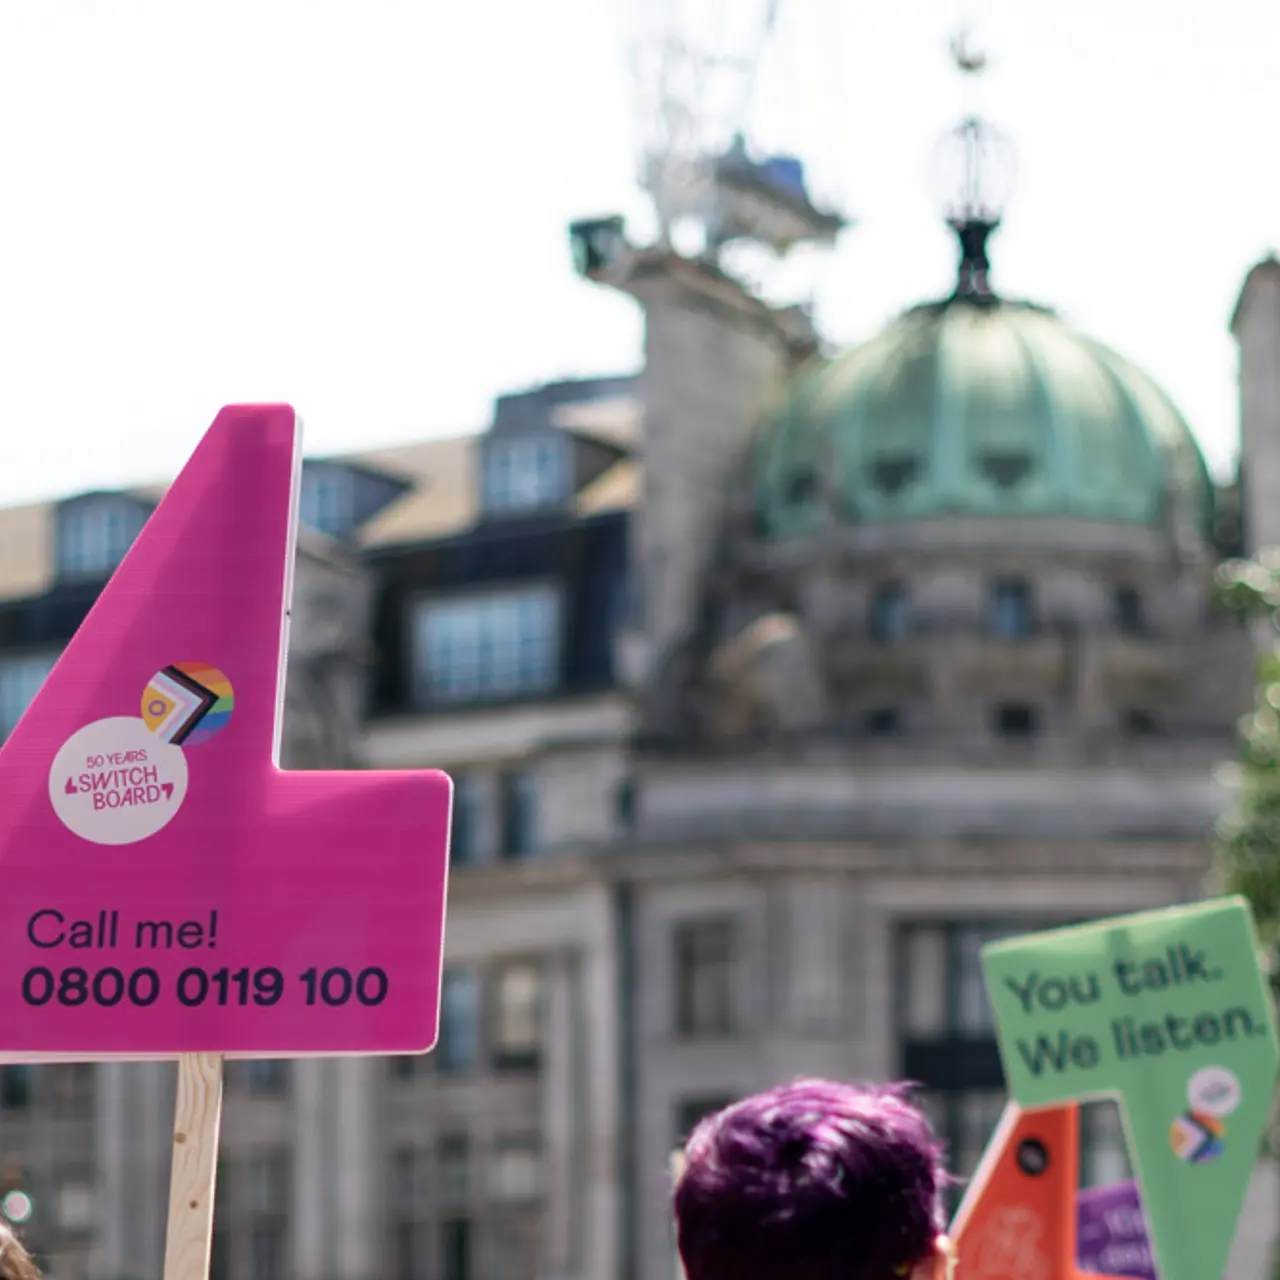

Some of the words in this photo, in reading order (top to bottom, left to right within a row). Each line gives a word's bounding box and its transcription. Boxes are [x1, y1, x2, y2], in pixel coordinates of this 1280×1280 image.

[87, 755, 104, 769] 50
[106, 749, 148, 765] YEARS
[26, 908, 119, 950] Call
[135, 908, 219, 949] me!
[21, 966, 160, 1007] 0800
[175, 966, 285, 1007] 0119
[299, 966, 390, 1007] 100
[1003, 968, 1102, 1016] You
[1016, 1027, 1102, 1079] We
